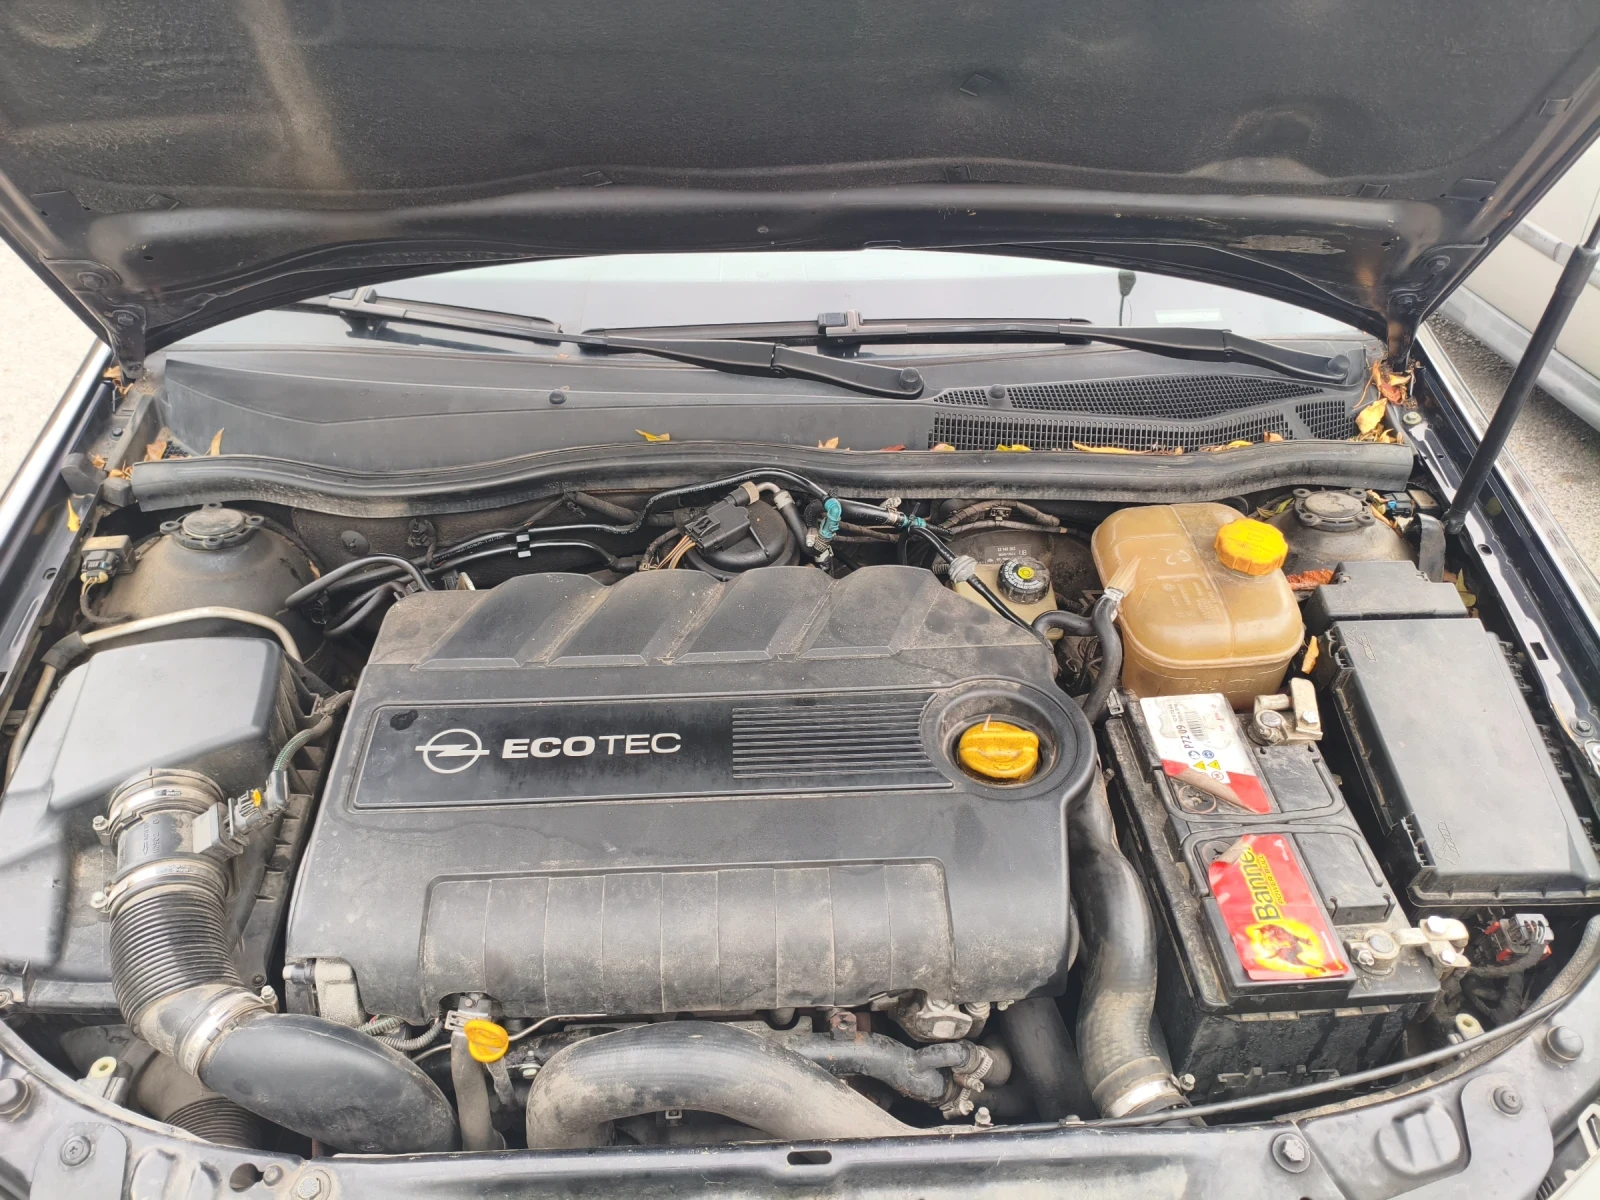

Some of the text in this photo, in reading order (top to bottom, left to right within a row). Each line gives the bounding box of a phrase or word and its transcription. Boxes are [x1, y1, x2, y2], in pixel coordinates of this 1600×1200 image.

[1176, 725, 1187, 734] 09
[501, 731, 682, 760] ECOTEC
[1181, 735, 1194, 749] P72
[1259, 856, 1271, 874] BULL
[1267, 876, 1284, 904] POWER
